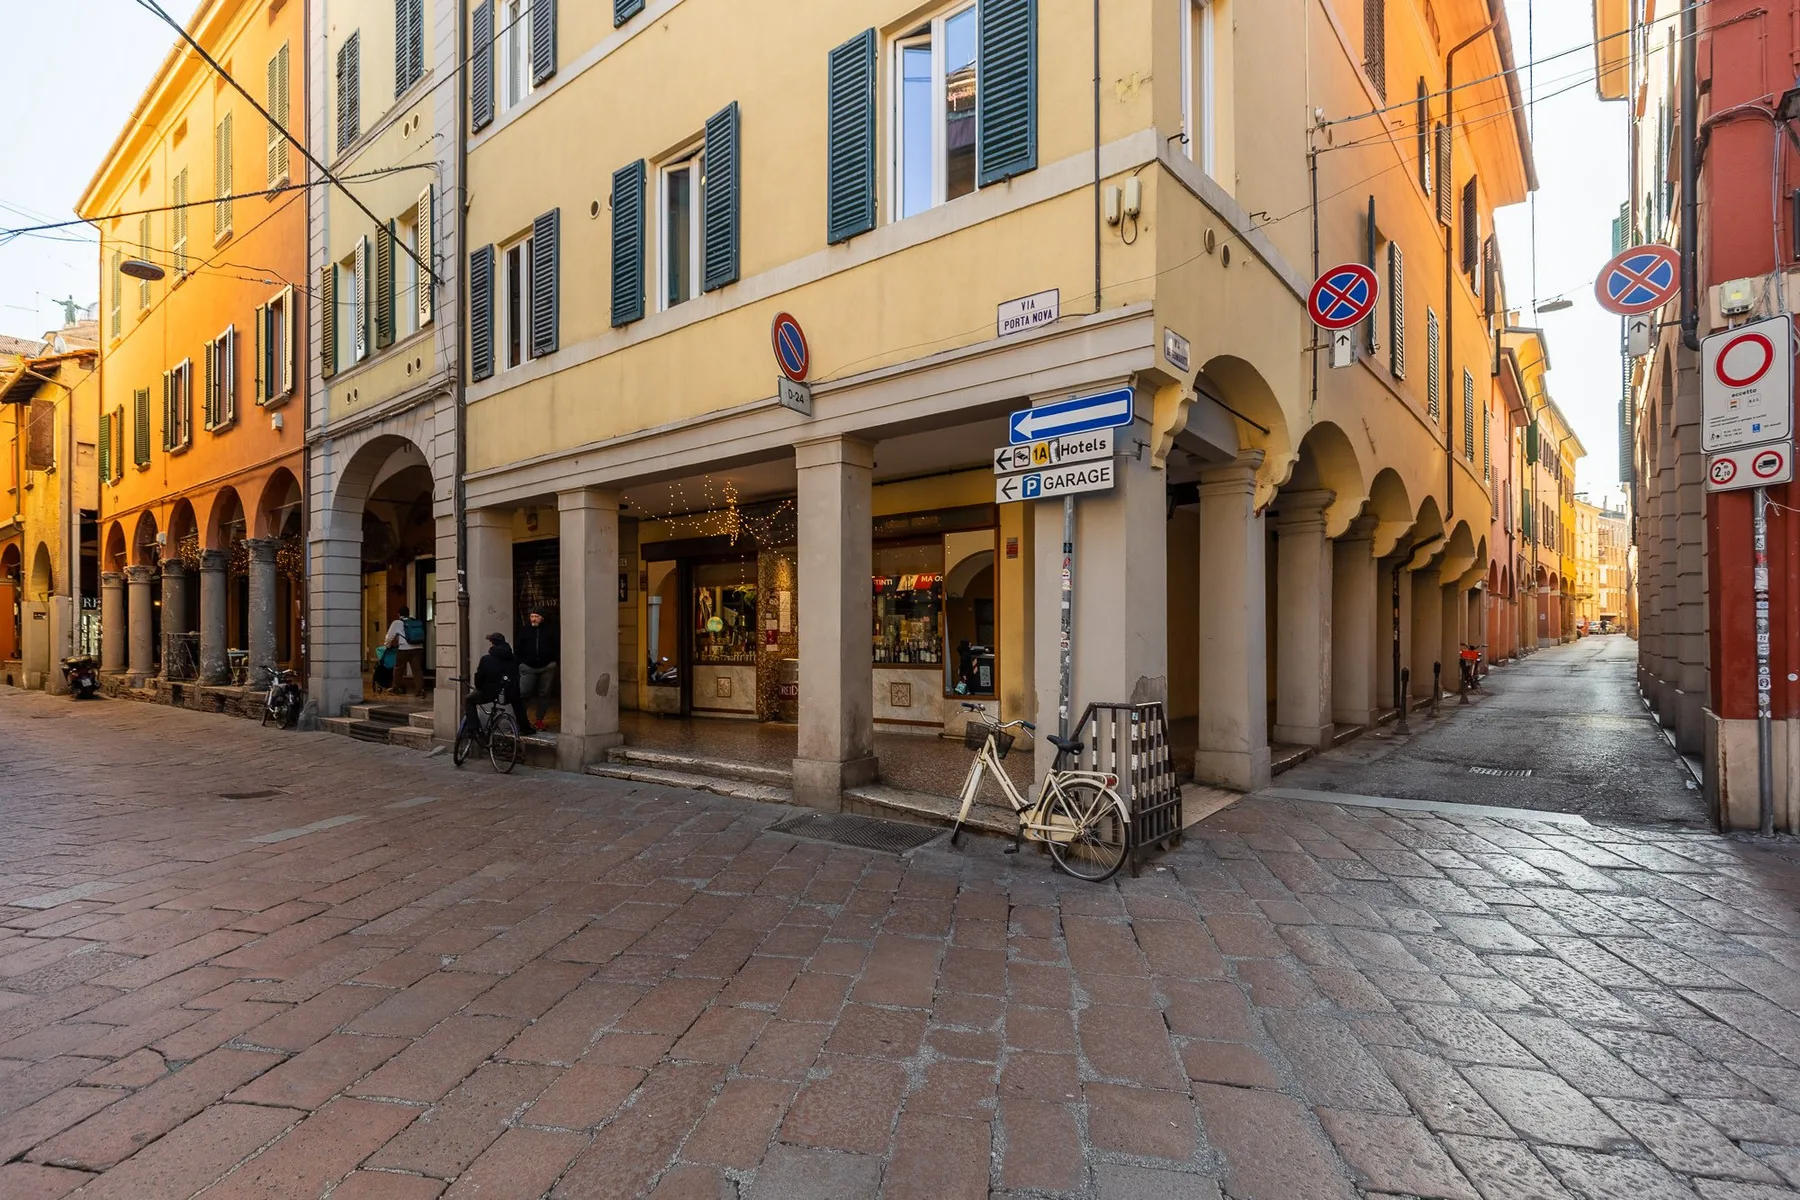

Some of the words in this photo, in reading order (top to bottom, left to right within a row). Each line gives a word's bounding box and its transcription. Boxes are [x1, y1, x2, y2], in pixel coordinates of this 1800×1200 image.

[1021, 299, 1035, 311] VIA
[1004, 315, 1030, 331] PORTA
[1032, 309, 1053, 323] NOVA
[1731, 388, 1757, 397] eccetto
[1033, 447, 1047, 461] 1A
[1061, 438, 1106, 456] Hotels
[1027, 480, 1037, 495] P
[1044, 467, 1111, 490] GARAGE
